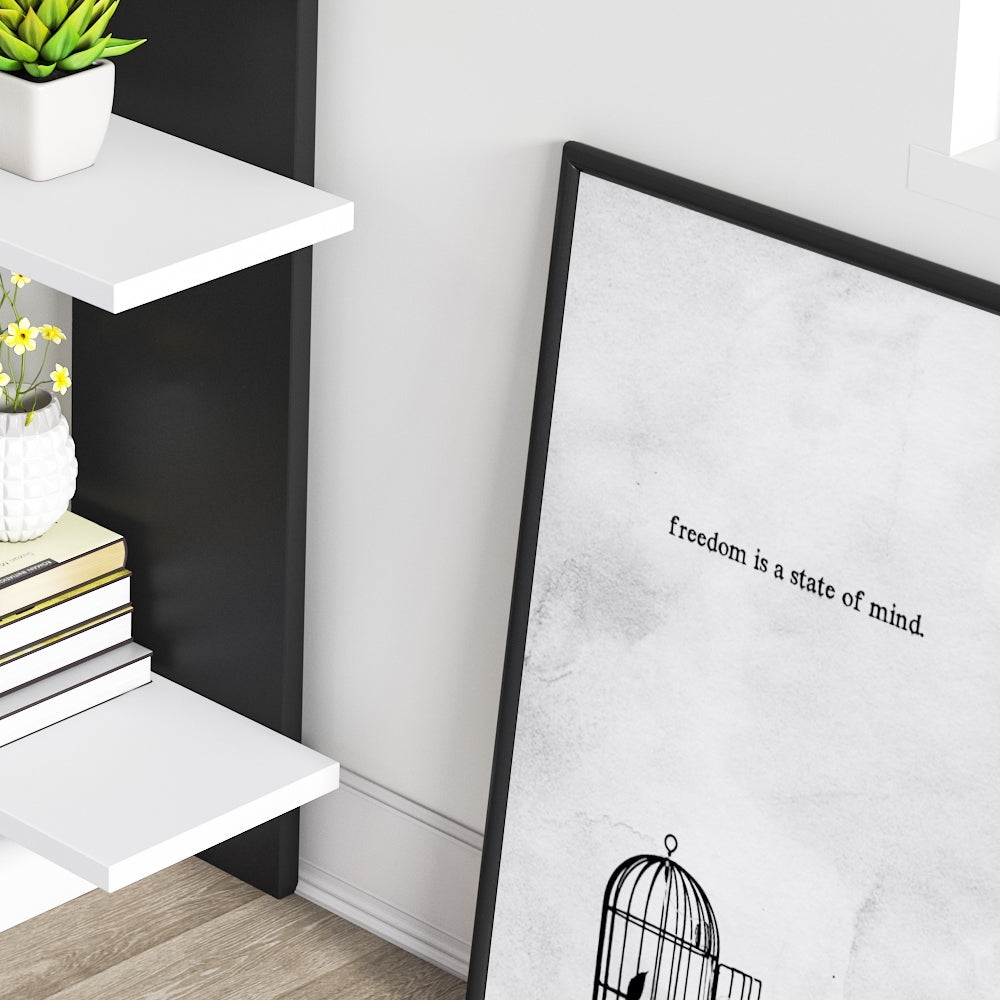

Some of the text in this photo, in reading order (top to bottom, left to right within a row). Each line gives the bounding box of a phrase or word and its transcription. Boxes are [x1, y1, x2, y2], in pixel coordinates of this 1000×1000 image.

[668, 515, 924, 638] freedom is a state of mind.
